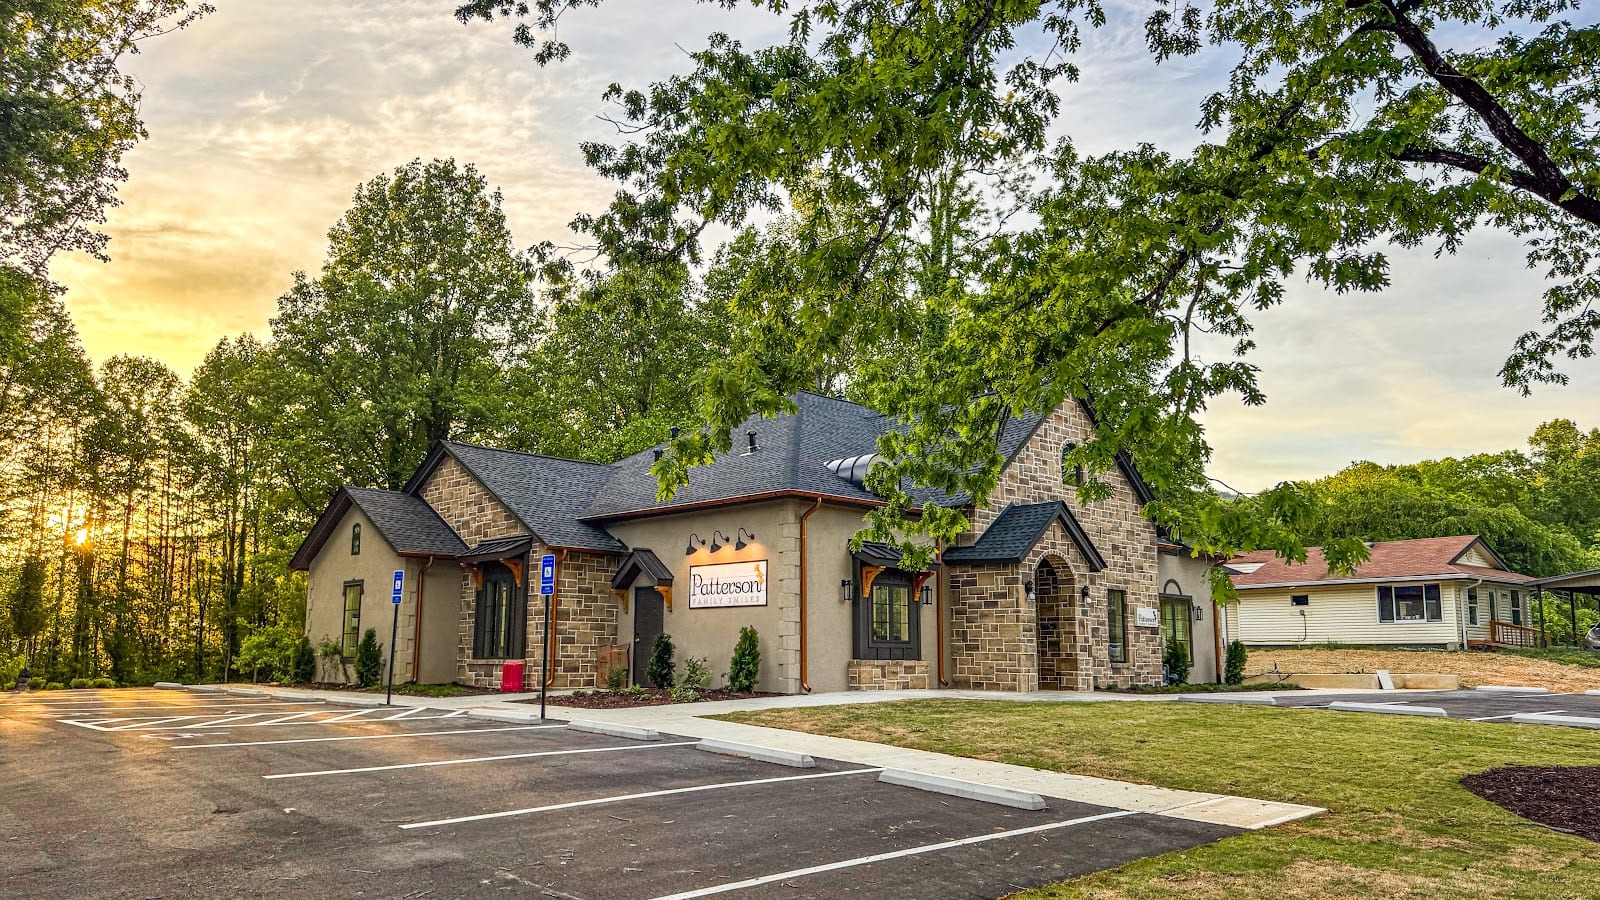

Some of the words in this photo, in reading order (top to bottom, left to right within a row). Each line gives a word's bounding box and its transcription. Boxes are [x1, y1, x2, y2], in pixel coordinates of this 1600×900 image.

[692, 574, 761, 596] Patterson
[692, 596, 723, 606] FAMILY
[728, 595, 760, 604] SMILES
